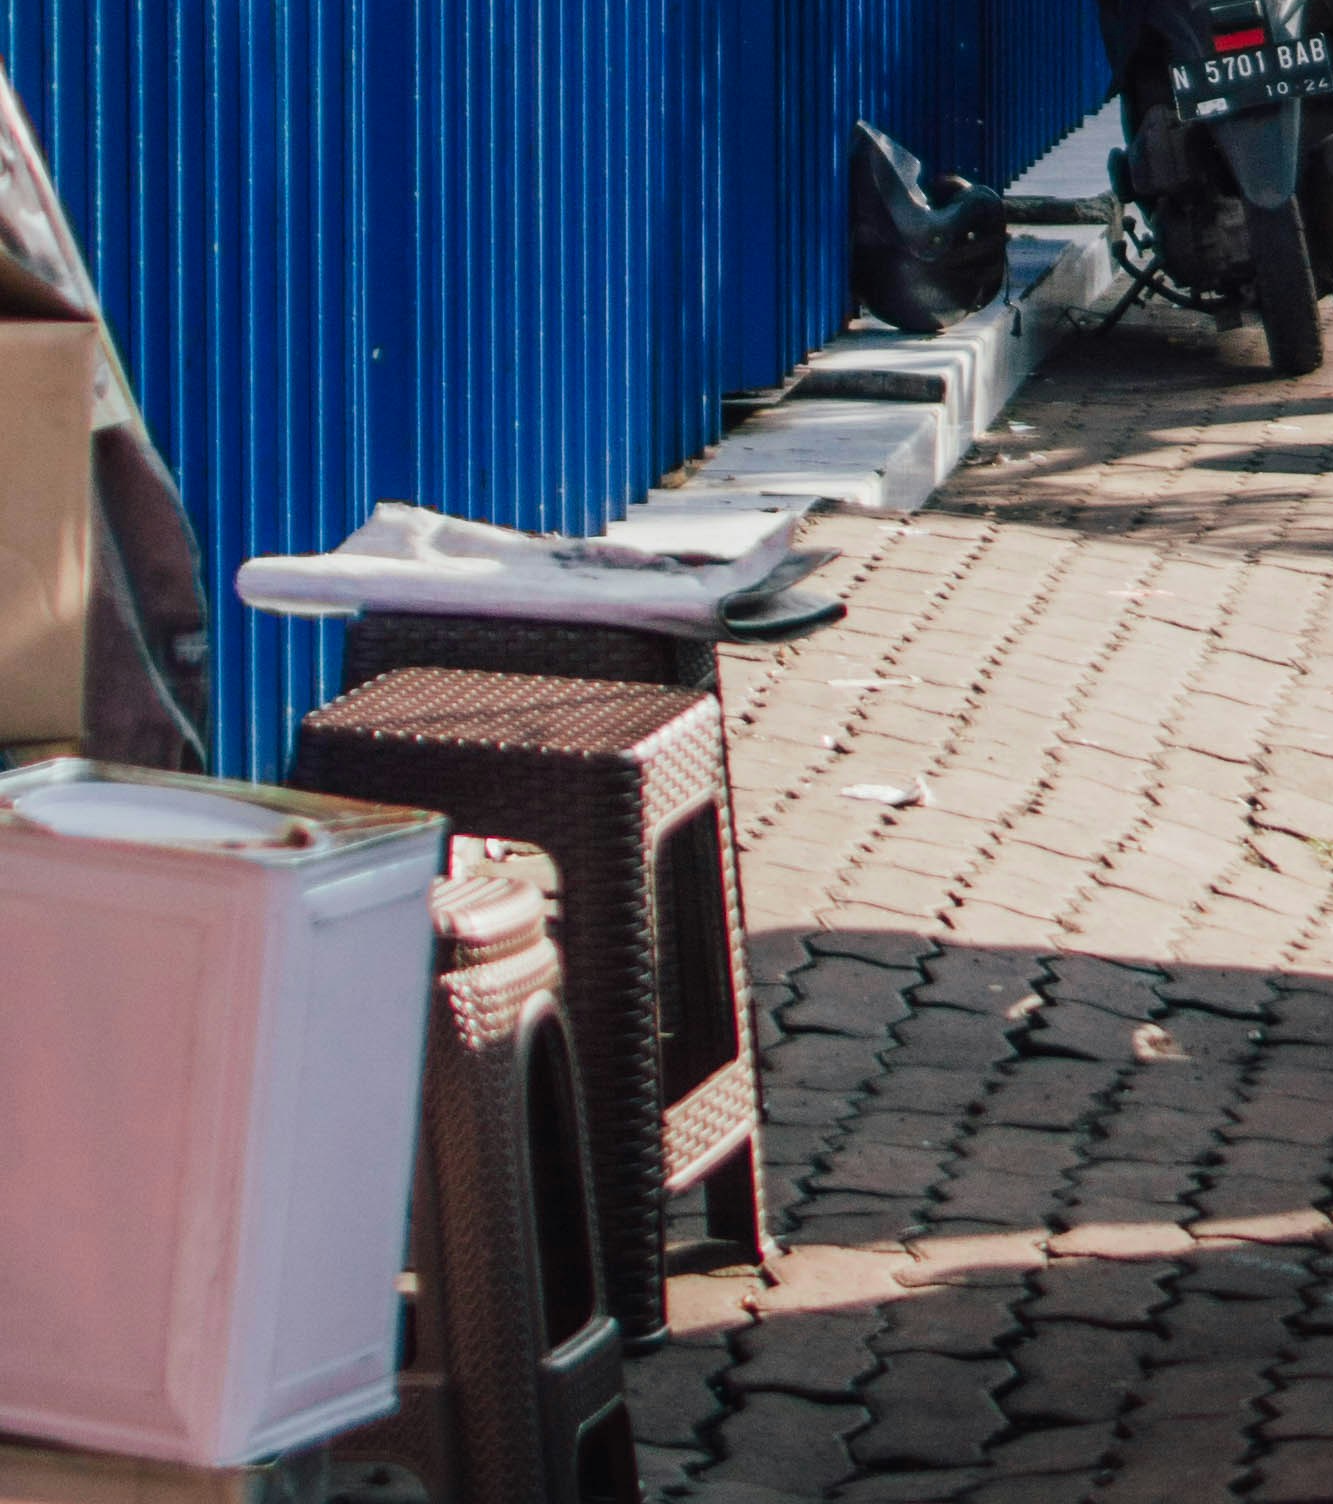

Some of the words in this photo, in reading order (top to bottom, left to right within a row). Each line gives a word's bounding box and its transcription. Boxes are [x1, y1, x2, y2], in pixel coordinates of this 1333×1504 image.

[1172, 65, 1191, 90] N
[1204, 50, 1266, 83] 5701
[1277, 37, 1326, 69] BAB
